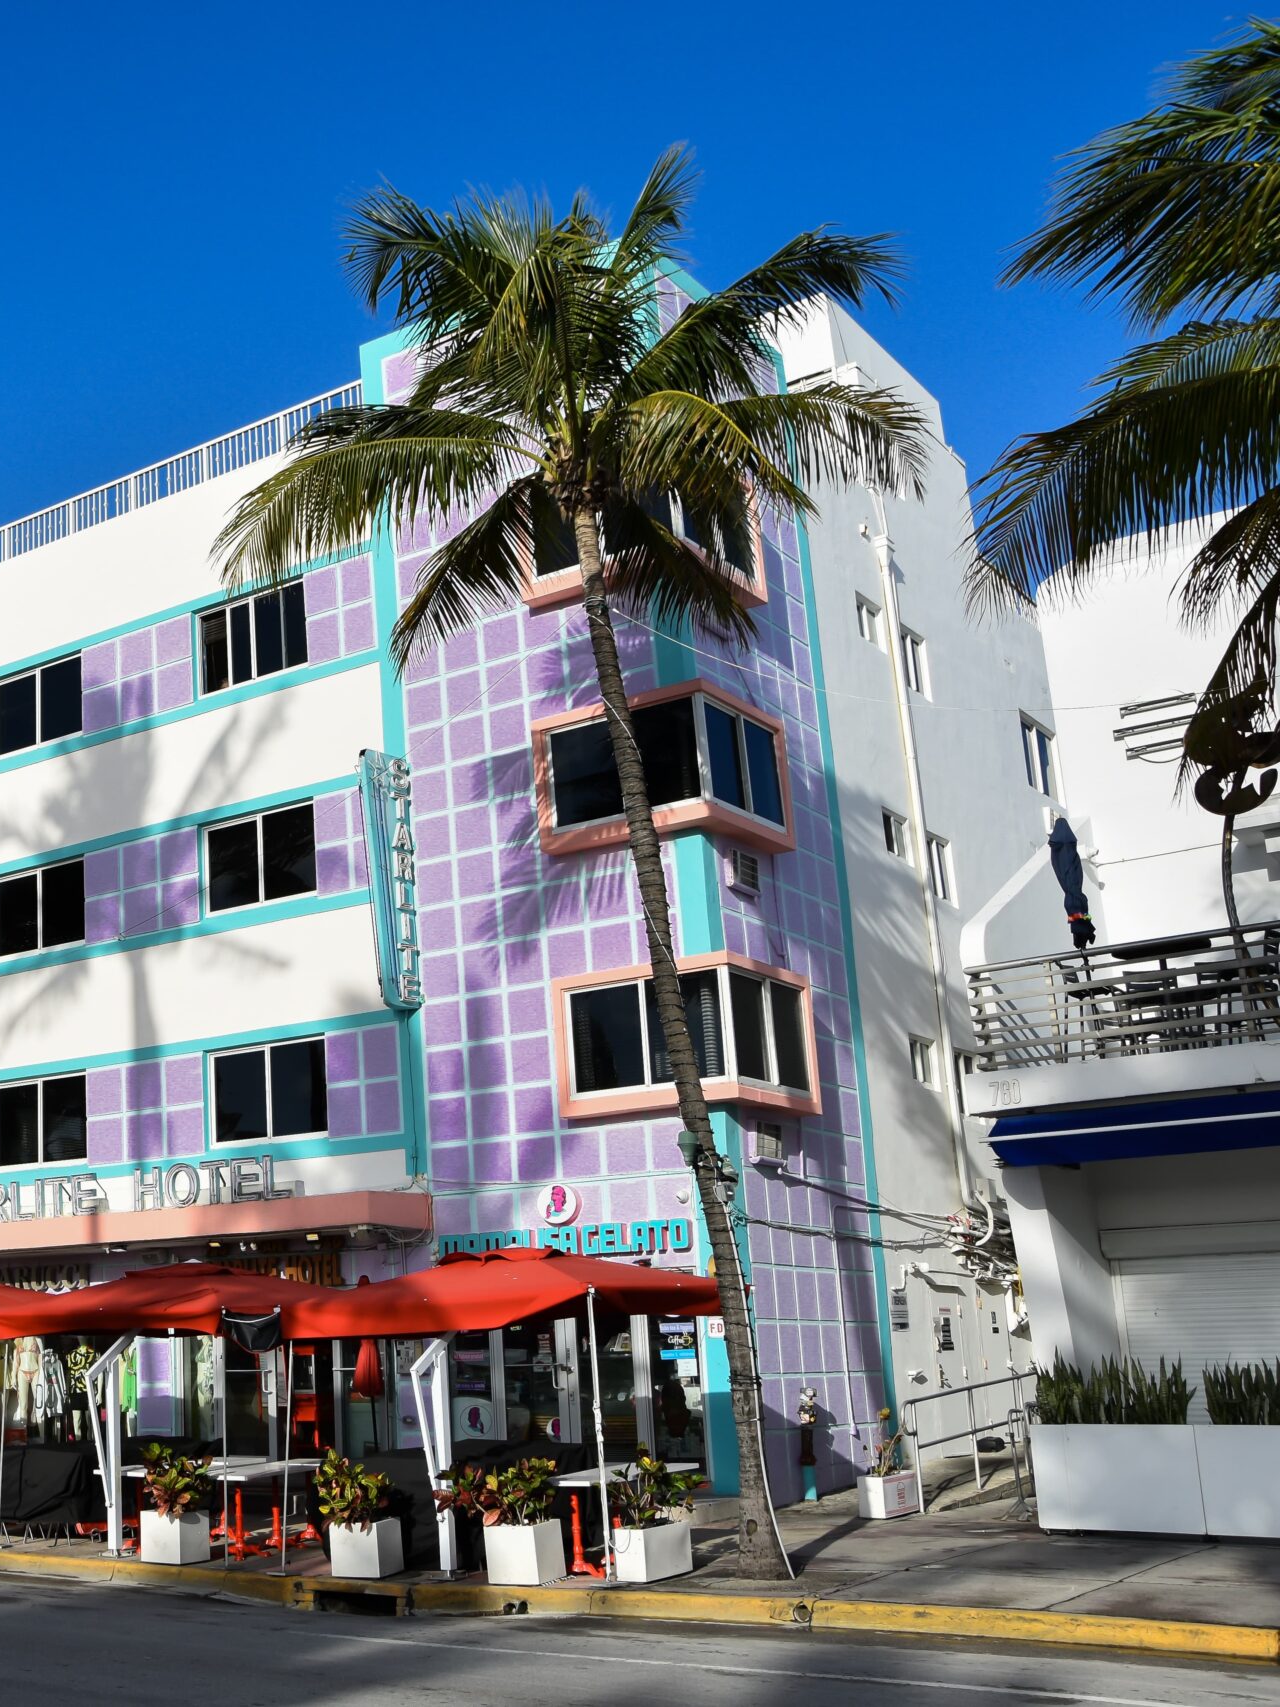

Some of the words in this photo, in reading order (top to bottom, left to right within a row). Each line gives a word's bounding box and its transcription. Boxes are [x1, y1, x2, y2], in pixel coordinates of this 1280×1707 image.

[389, 758, 417, 1001] STARLITE
[988, 1078, 1022, 1107] 760
[134, 1154, 291, 1212] HOTEL
[581, 1219, 690, 1255] GELATO
